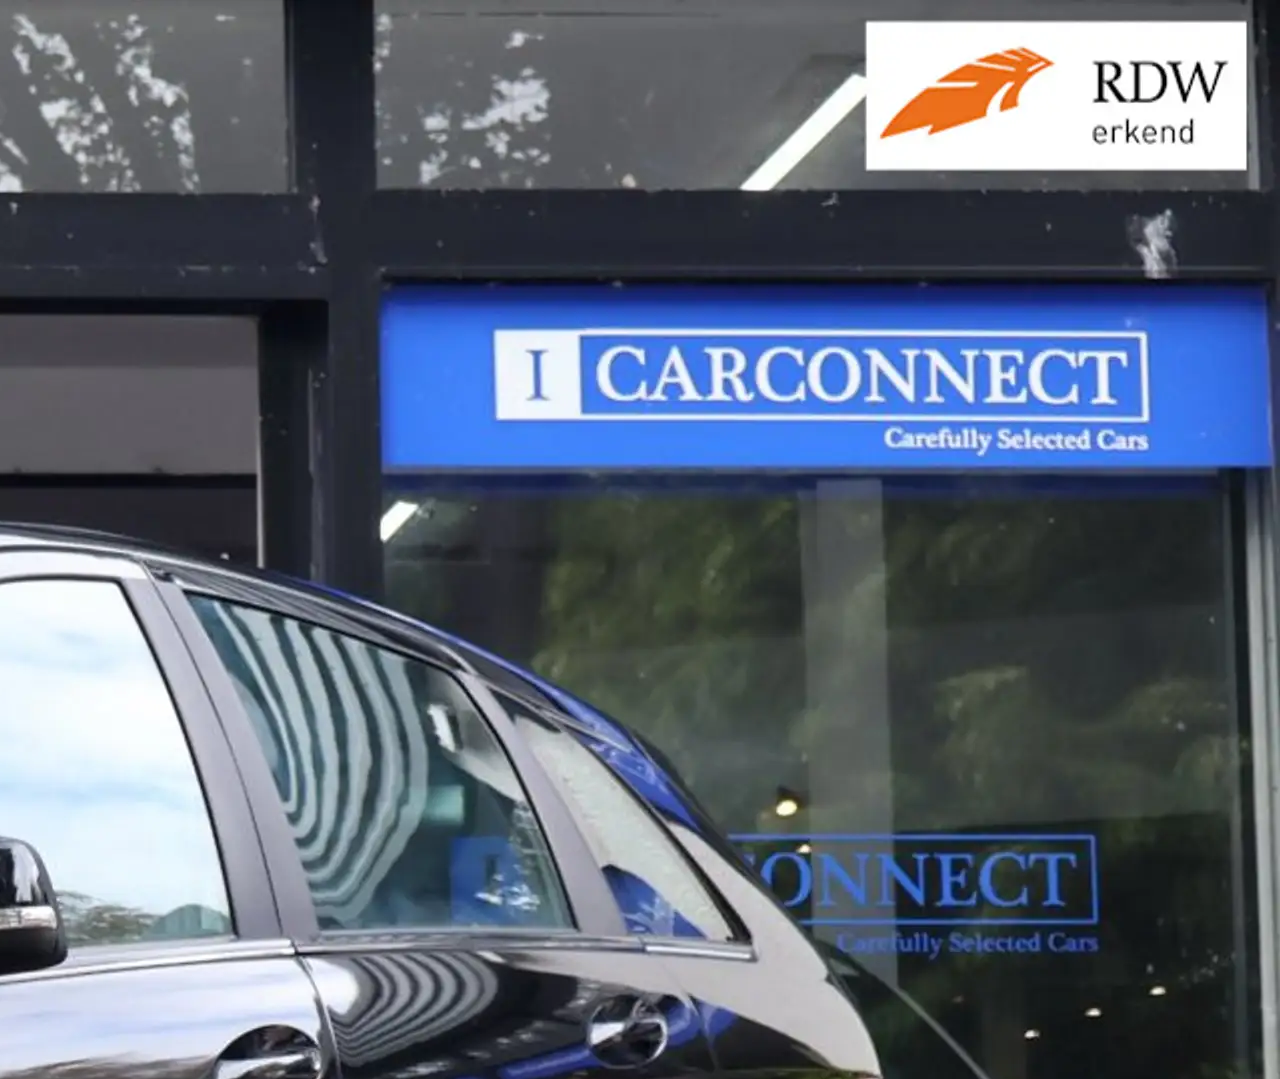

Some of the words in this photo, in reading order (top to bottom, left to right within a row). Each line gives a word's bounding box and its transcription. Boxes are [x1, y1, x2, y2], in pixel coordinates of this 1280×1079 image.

[525, 348, 548, 400] I
[596, 345, 1128, 407] CARCONNECT
[884, 426, 992, 456] Carefully
[997, 428, 1091, 450] Selected
[1097, 429, 1149, 451] Cars
[744, 850, 1078, 908] ONNECT
[949, 932, 1040, 953] Selected
[1047, 933, 1099, 953] Cars
